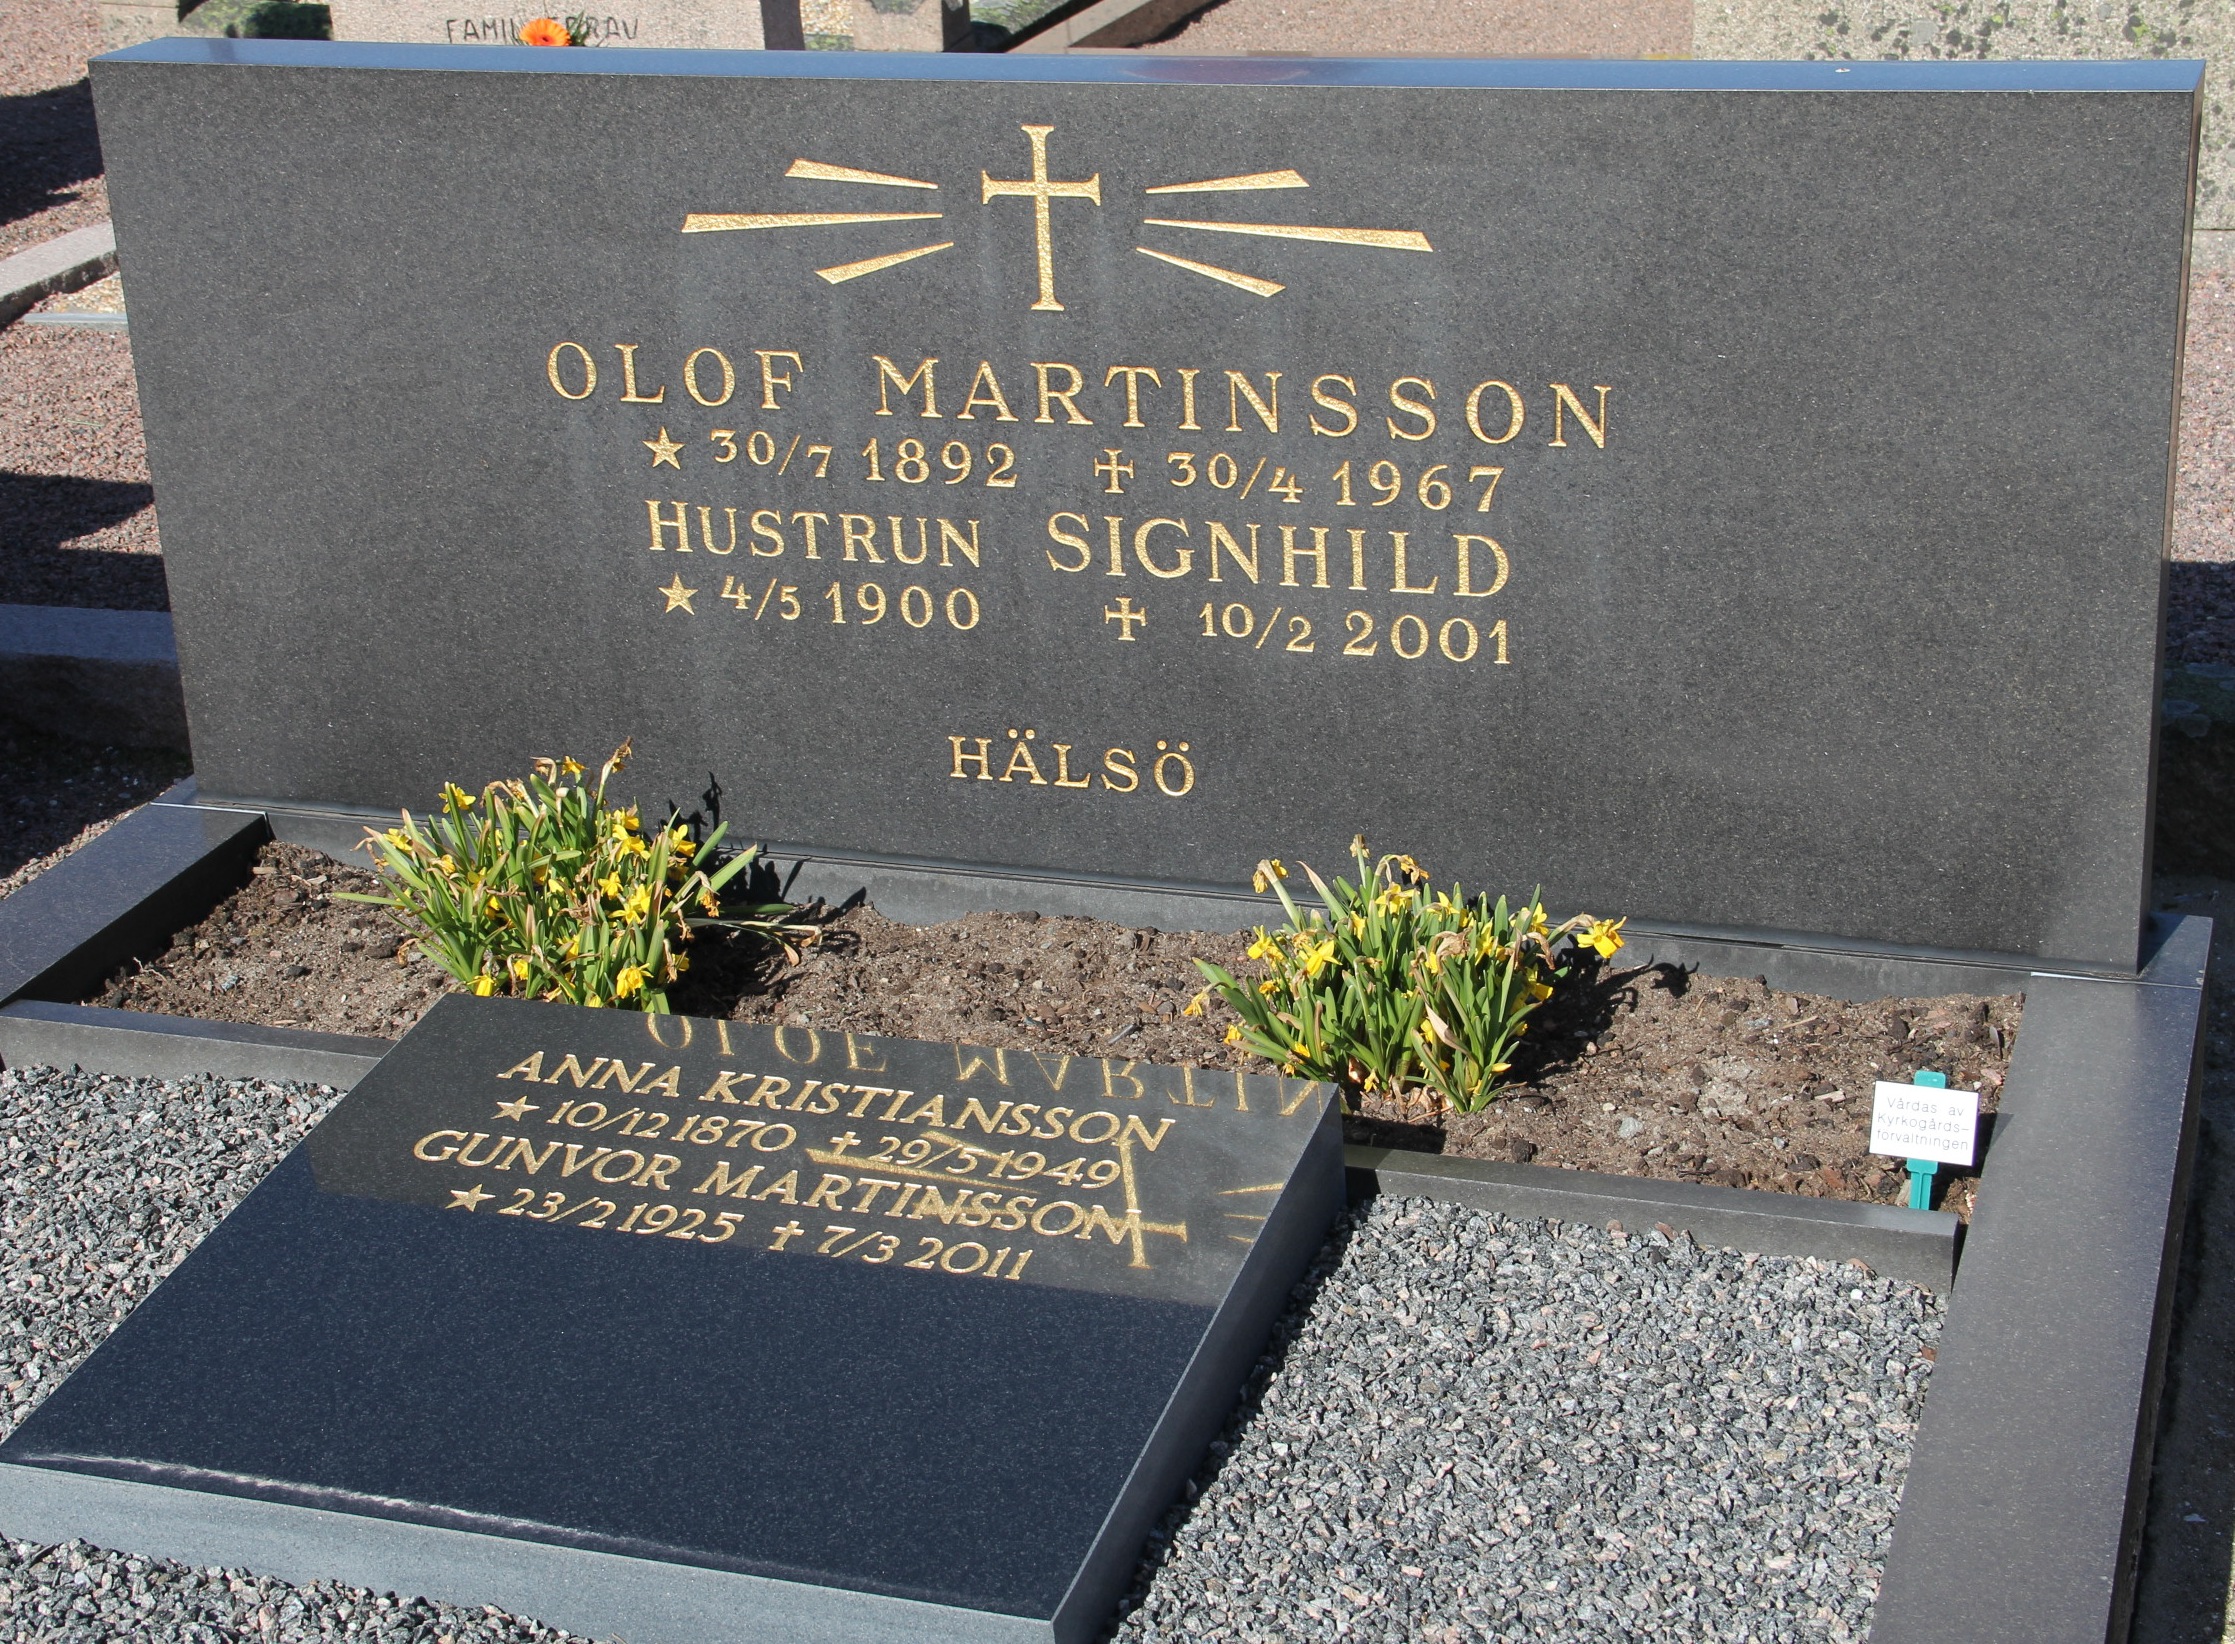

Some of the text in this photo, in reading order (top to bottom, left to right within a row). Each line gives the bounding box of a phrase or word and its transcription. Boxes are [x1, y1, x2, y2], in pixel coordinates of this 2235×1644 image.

[446, 16, 638, 43] FAMILRAV
[546, 341, 1613, 449] OLOF MARTINSSON
[709, 428, 1505, 512] 30/7 1892 30/4 1967
[645, 499, 1511, 598] HUSTRUN SIGNHILD
[720, 575, 1511, 664] 4/5 1900 10/2 2001
[948, 728, 1197, 796] HÄLSÖ
[496, 1050, 1177, 1152] ANNA KRISTIANSSON
[546, 1098, 1121, 1190] 10/12 1870 29/5 1949
[1887, 1097, 1965, 1117] Vårdas av
[412, 1129, 1142, 1246] GUNVOR MARTINSSON
[497, 1187, 1034, 1281] 23/2 1925 7/3 2011
